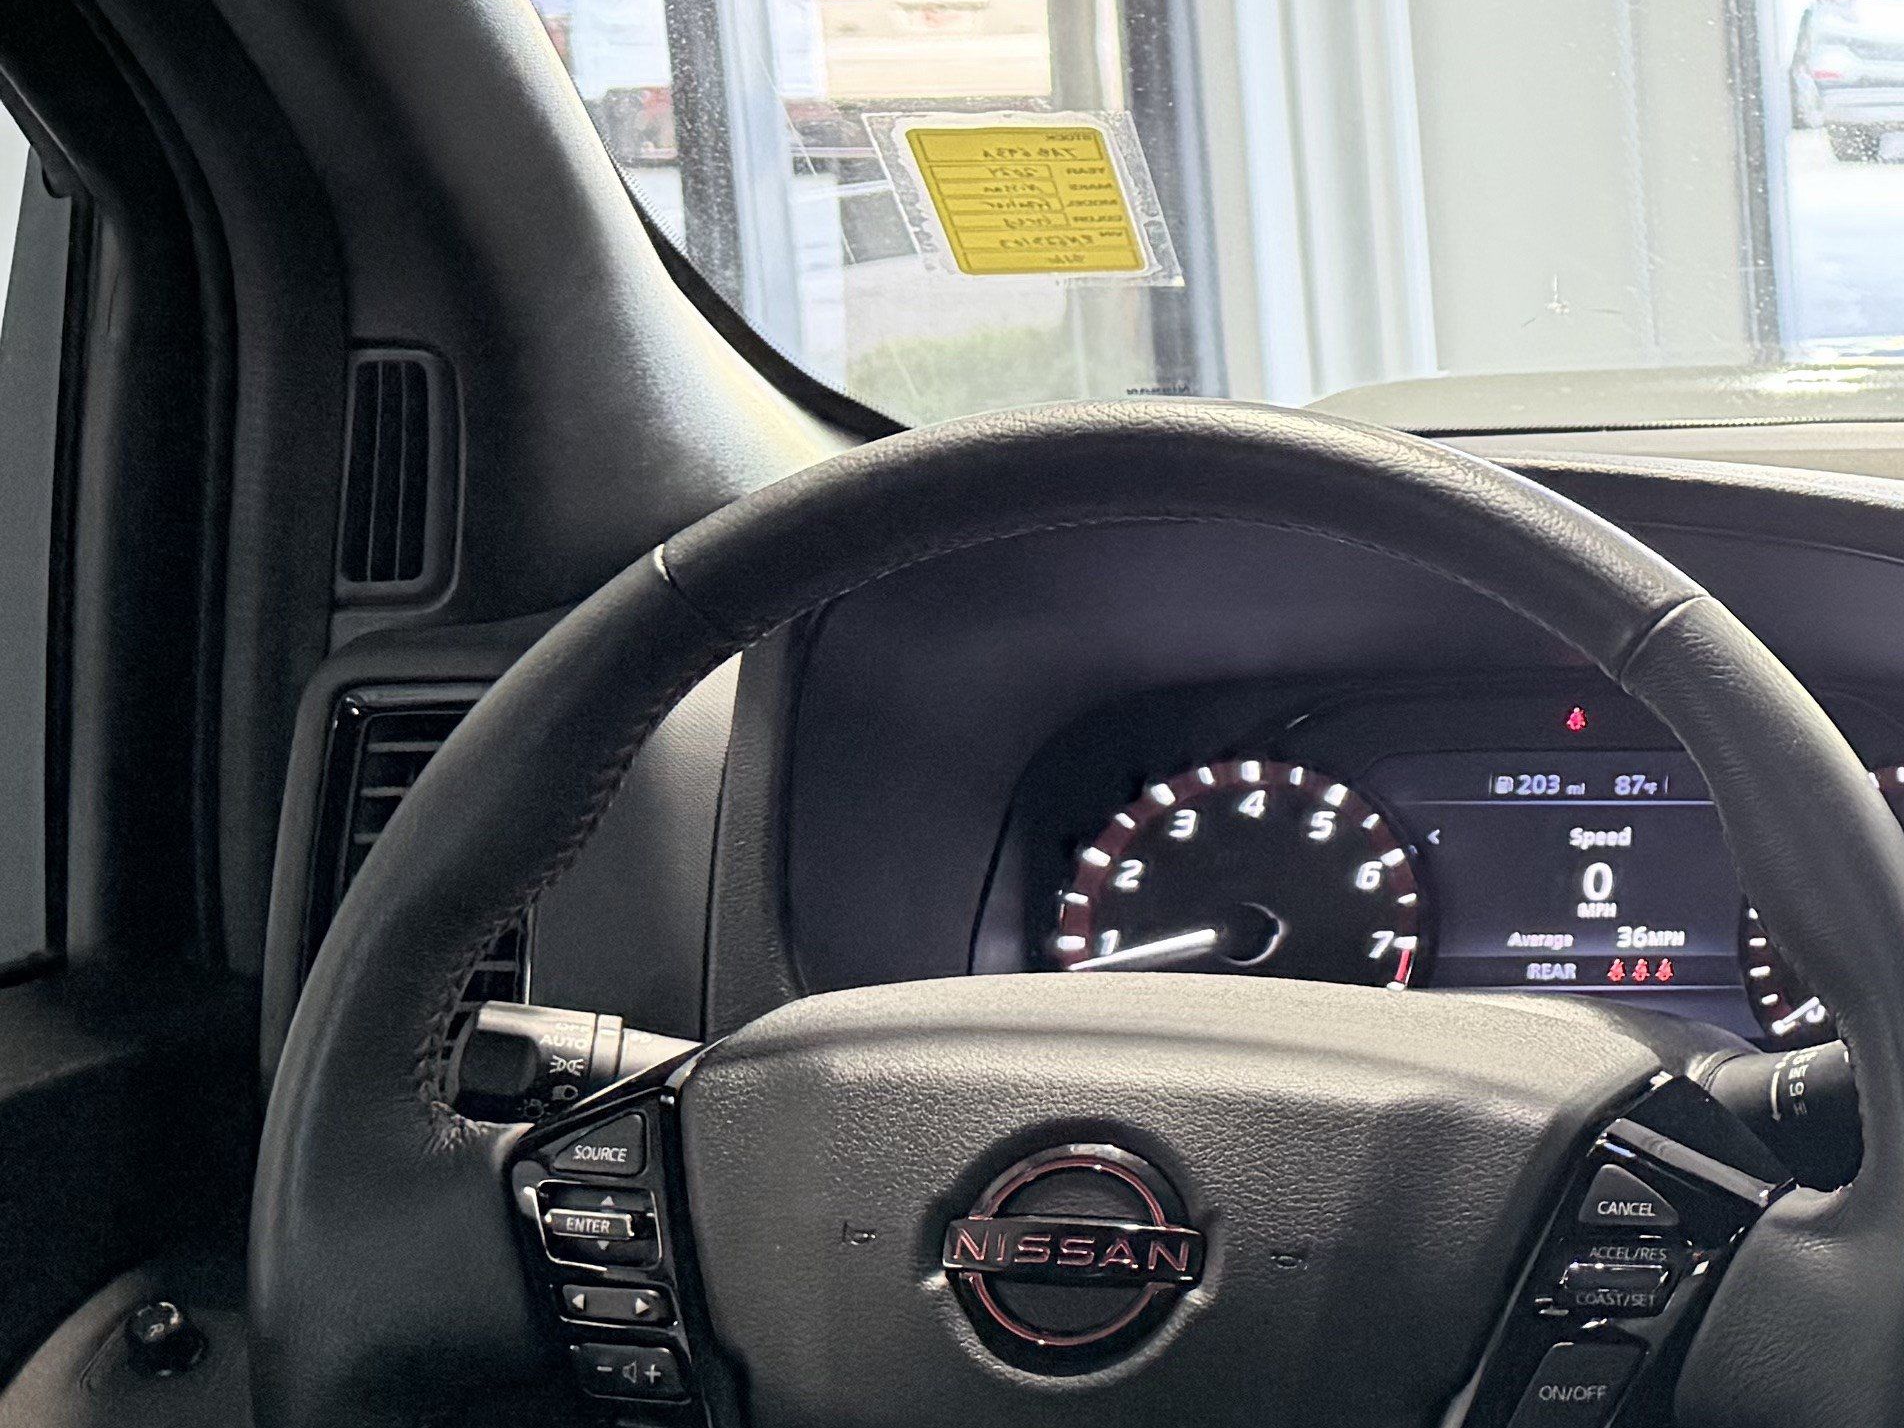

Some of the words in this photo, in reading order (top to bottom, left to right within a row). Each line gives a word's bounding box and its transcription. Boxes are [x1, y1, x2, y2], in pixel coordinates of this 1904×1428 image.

[1516, 774, 1561, 795] 203
[1238, 789, 1267, 818] 4
[1168, 809, 1197, 838] 3
[1307, 810, 1337, 840] 5
[1568, 826, 1633, 850] Speed
[1115, 859, 1144, 889] 2
[1355, 860, 1384, 890] 6
[1582, 862, 1613, 901] 0
[1577, 902, 1618, 918] MPH
[1100, 929, 1120, 955] 1
[1368, 930, 1395, 959] 7
[1506, 931, 1575, 951] Average
[1527, 963, 1578, 980] REAR
[573, 1143, 628, 1164] SOURCE
[1597, 1200, 1657, 1218] CANCEL
[565, 1216, 612, 1235] ENTER
[956, 1226, 1192, 1272] NISSAN
[1588, 1244, 1669, 1262] ACCEL/RES
[1538, 1384, 1608, 1402] ON/OFF
